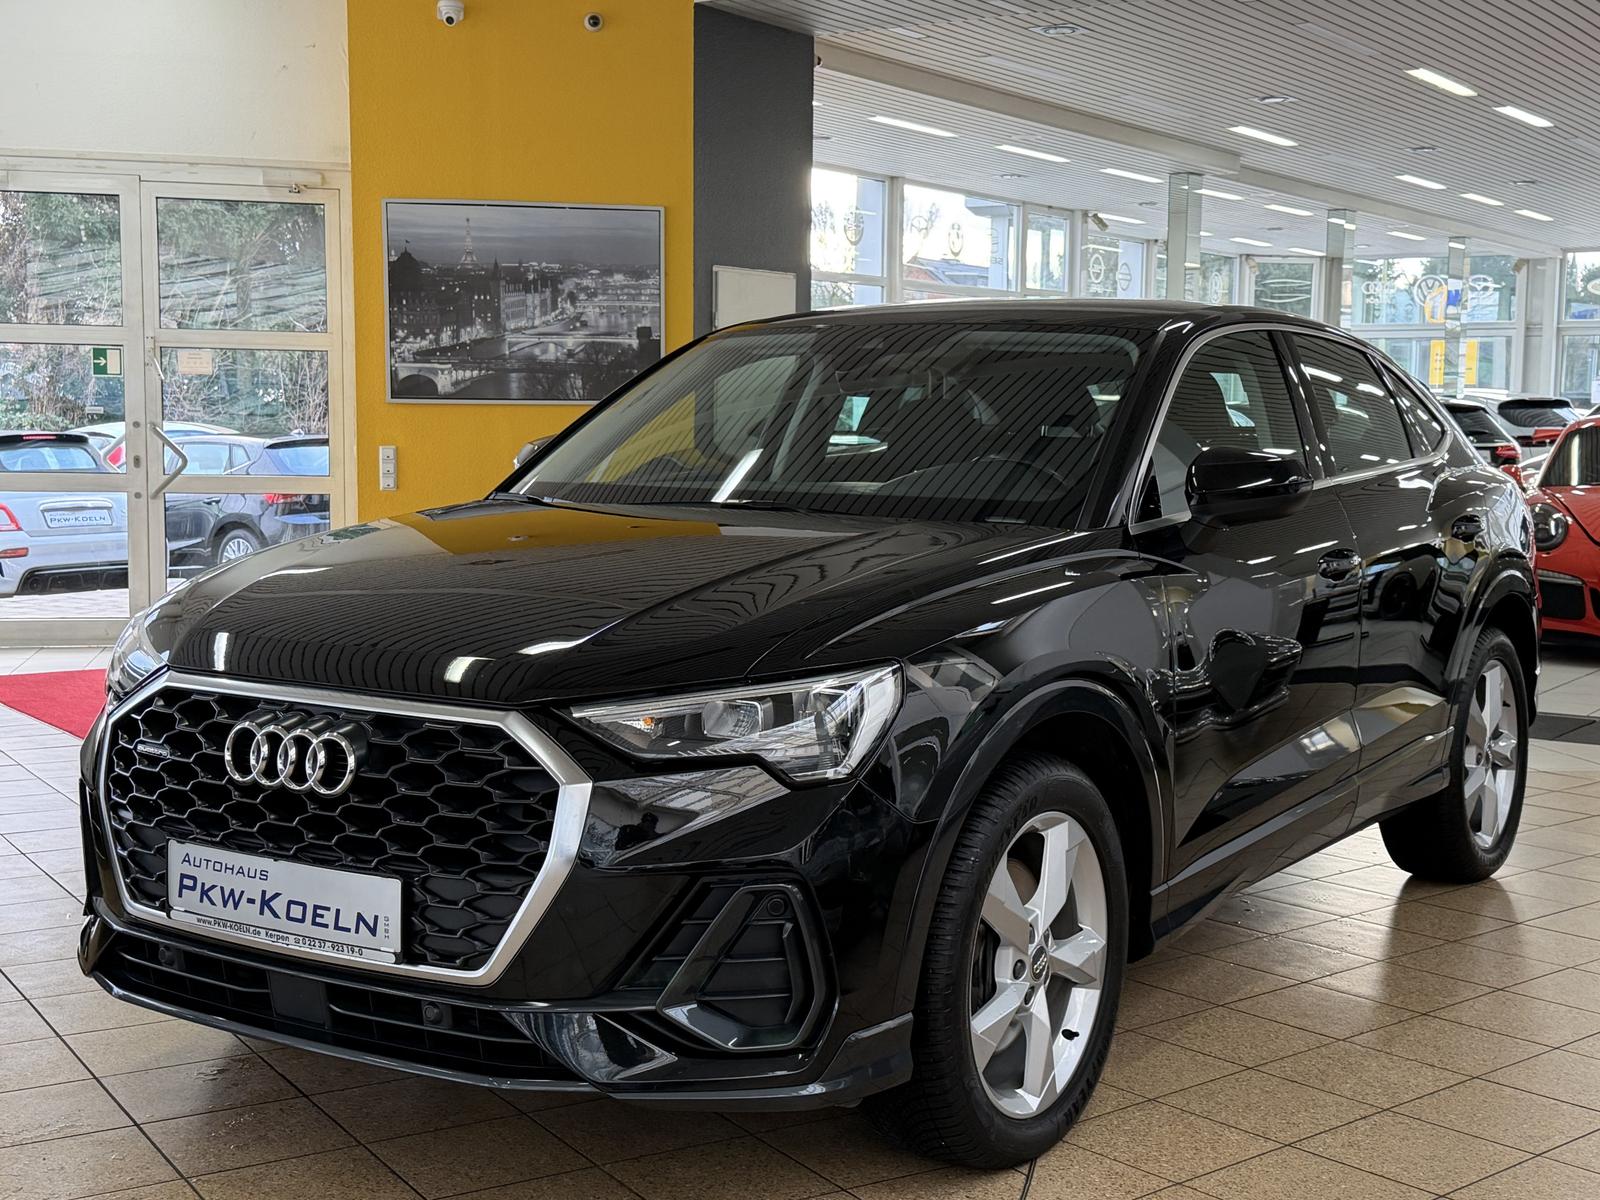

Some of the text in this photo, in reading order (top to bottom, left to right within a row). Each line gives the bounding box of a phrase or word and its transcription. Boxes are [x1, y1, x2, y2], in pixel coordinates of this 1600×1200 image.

[181, 852, 270, 881] AUTOHAUS
[177, 872, 379, 938] PKW-KOELN
[196, 916, 262, 937] www.PKW-KOELN.de
[264, 930, 290, 943] Kerpen
